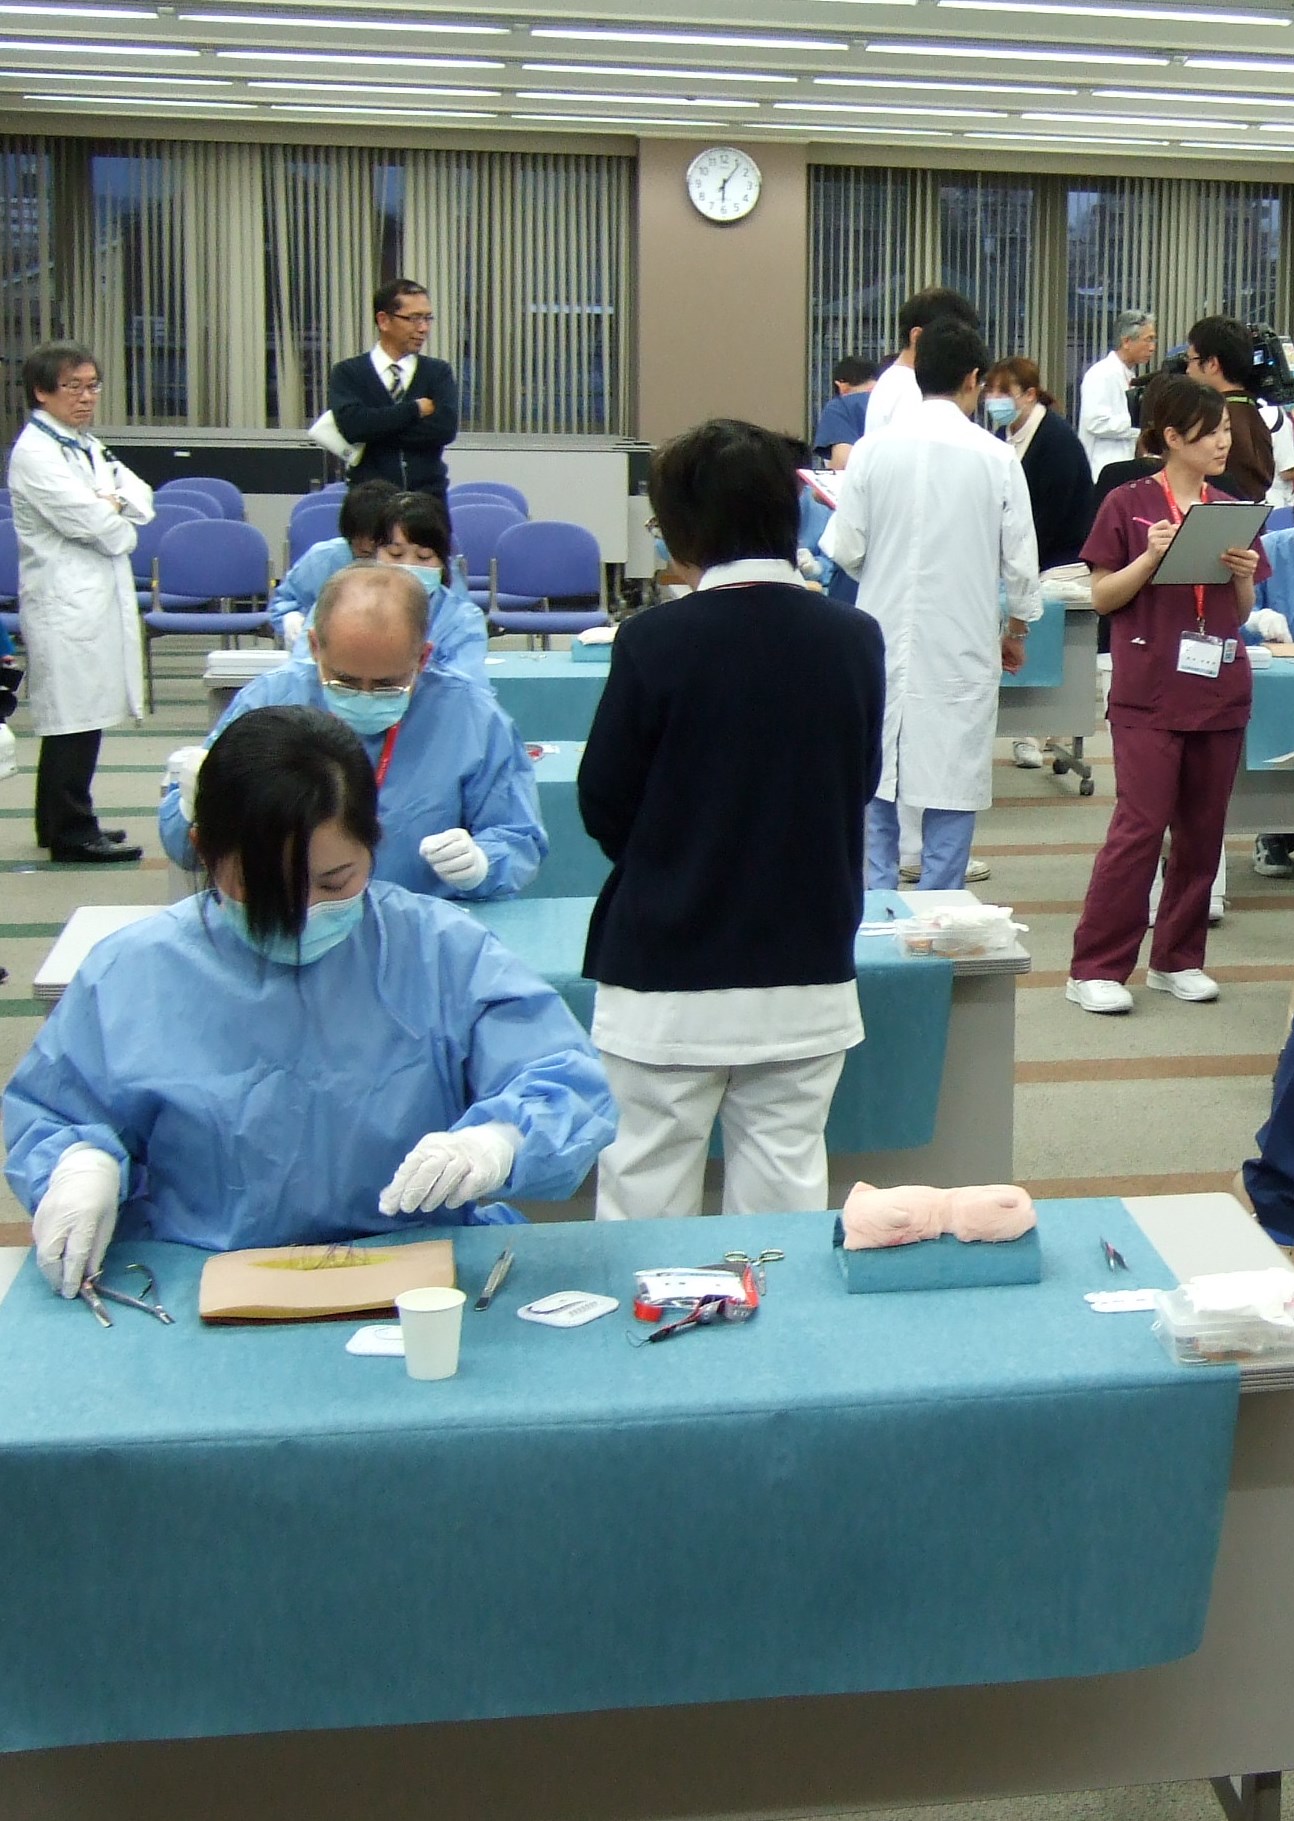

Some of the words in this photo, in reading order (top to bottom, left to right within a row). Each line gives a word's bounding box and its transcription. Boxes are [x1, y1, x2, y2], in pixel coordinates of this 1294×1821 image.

[742, 167, 749, 177] 2
[742, 194, 749, 202] 4
[733, 202, 740, 212] 5
